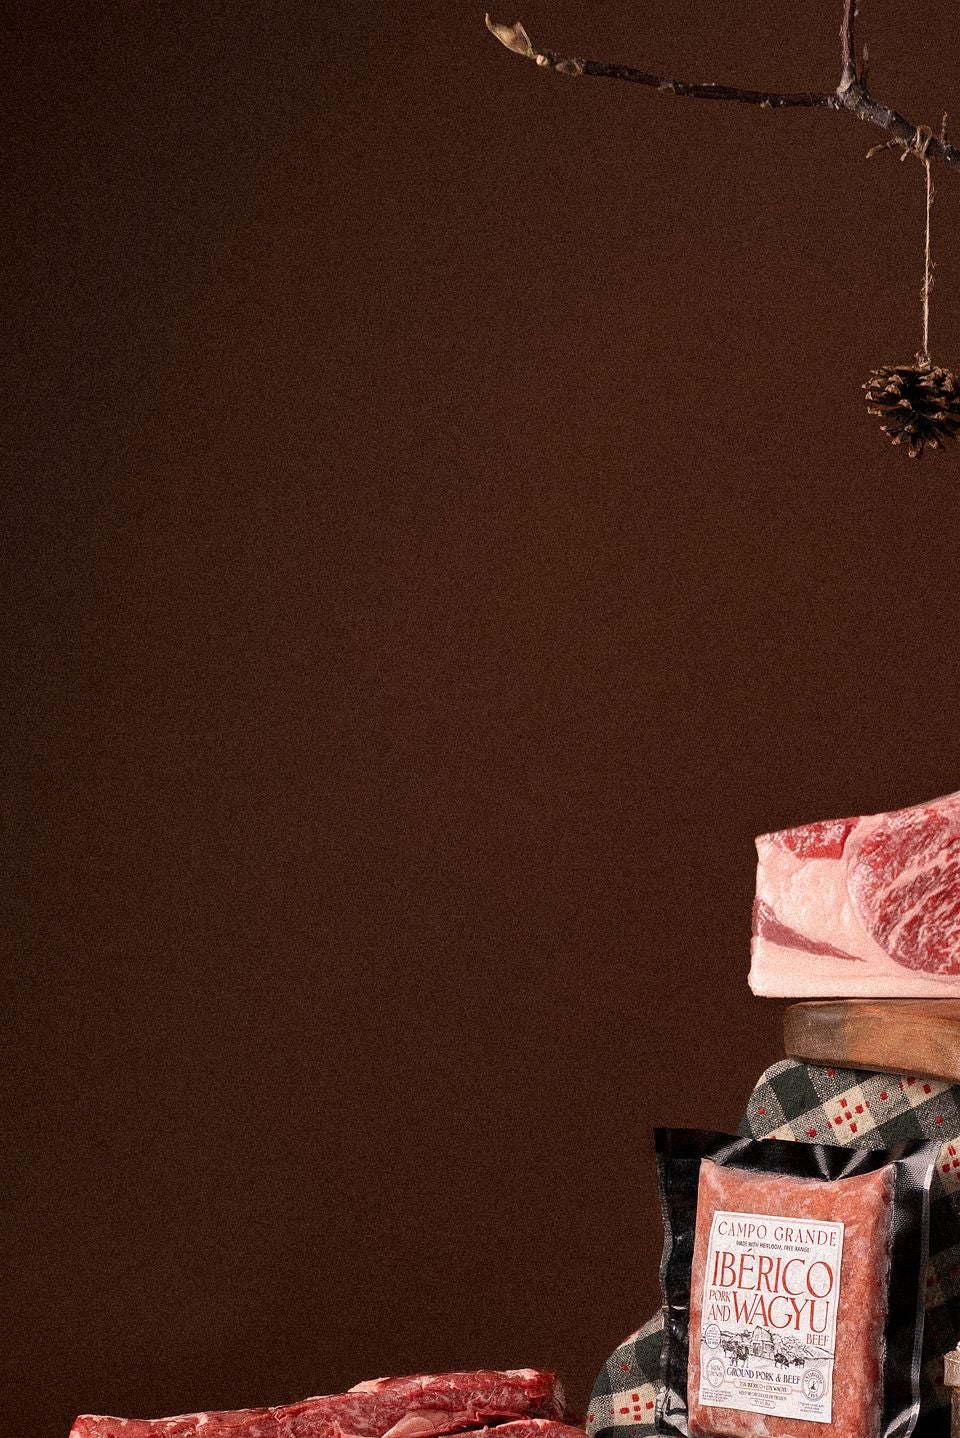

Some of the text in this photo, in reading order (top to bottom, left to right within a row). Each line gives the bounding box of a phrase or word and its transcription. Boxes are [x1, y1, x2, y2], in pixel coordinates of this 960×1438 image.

[718, 1221, 837, 1246] CAMPO GRANDE
[712, 1248, 834, 1298] IBÉRICO
[709, 1289, 731, 1302] PORK
[708, 1290, 830, 1333] AND WAGYU
[806, 1333, 830, 1346] BEEF
[726, 1367, 754, 1379] GROUND
[755, 1371, 774, 1382] PORK
[775, 1374, 781, 1382] &
[783, 1374, 801, 1385] BEEF
